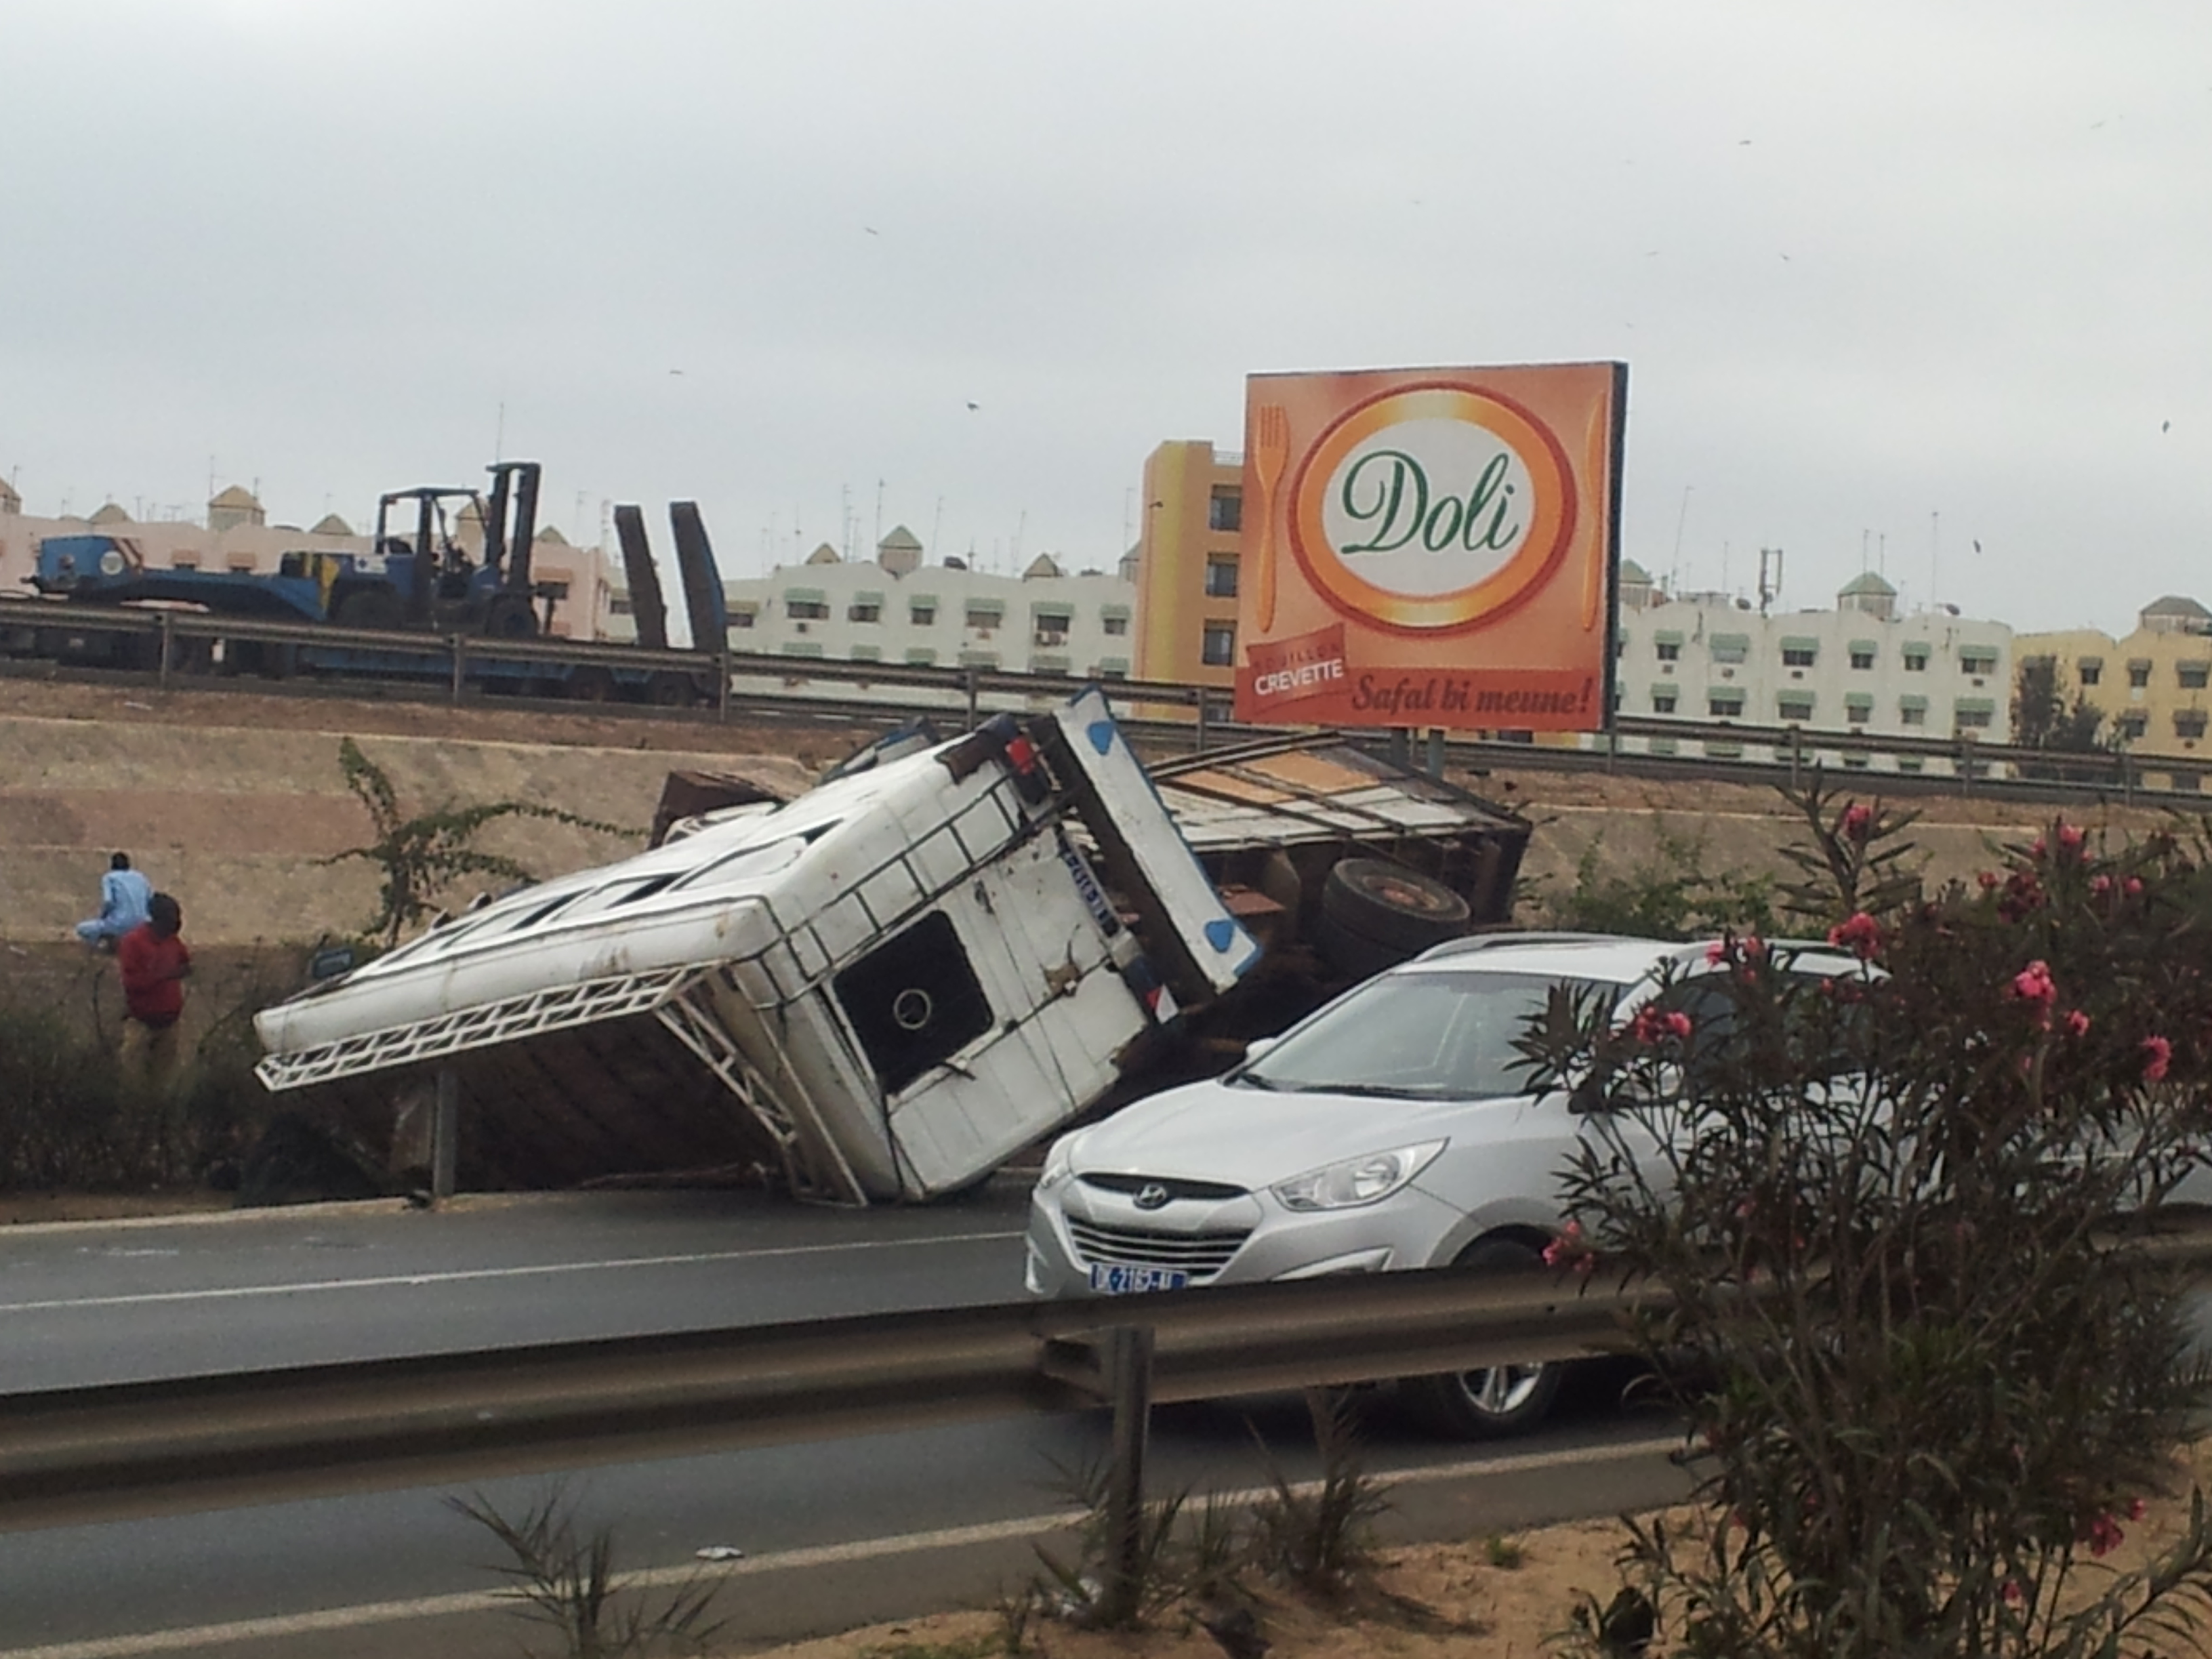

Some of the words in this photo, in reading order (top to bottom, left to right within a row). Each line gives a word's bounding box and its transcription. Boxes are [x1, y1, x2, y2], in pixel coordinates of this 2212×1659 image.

[1341, 450, 1519, 554] Doli
[1254, 659, 1344, 695] CREVETTE
[1353, 674, 1436, 716] Safal
[1441, 678, 1470, 711] bi
